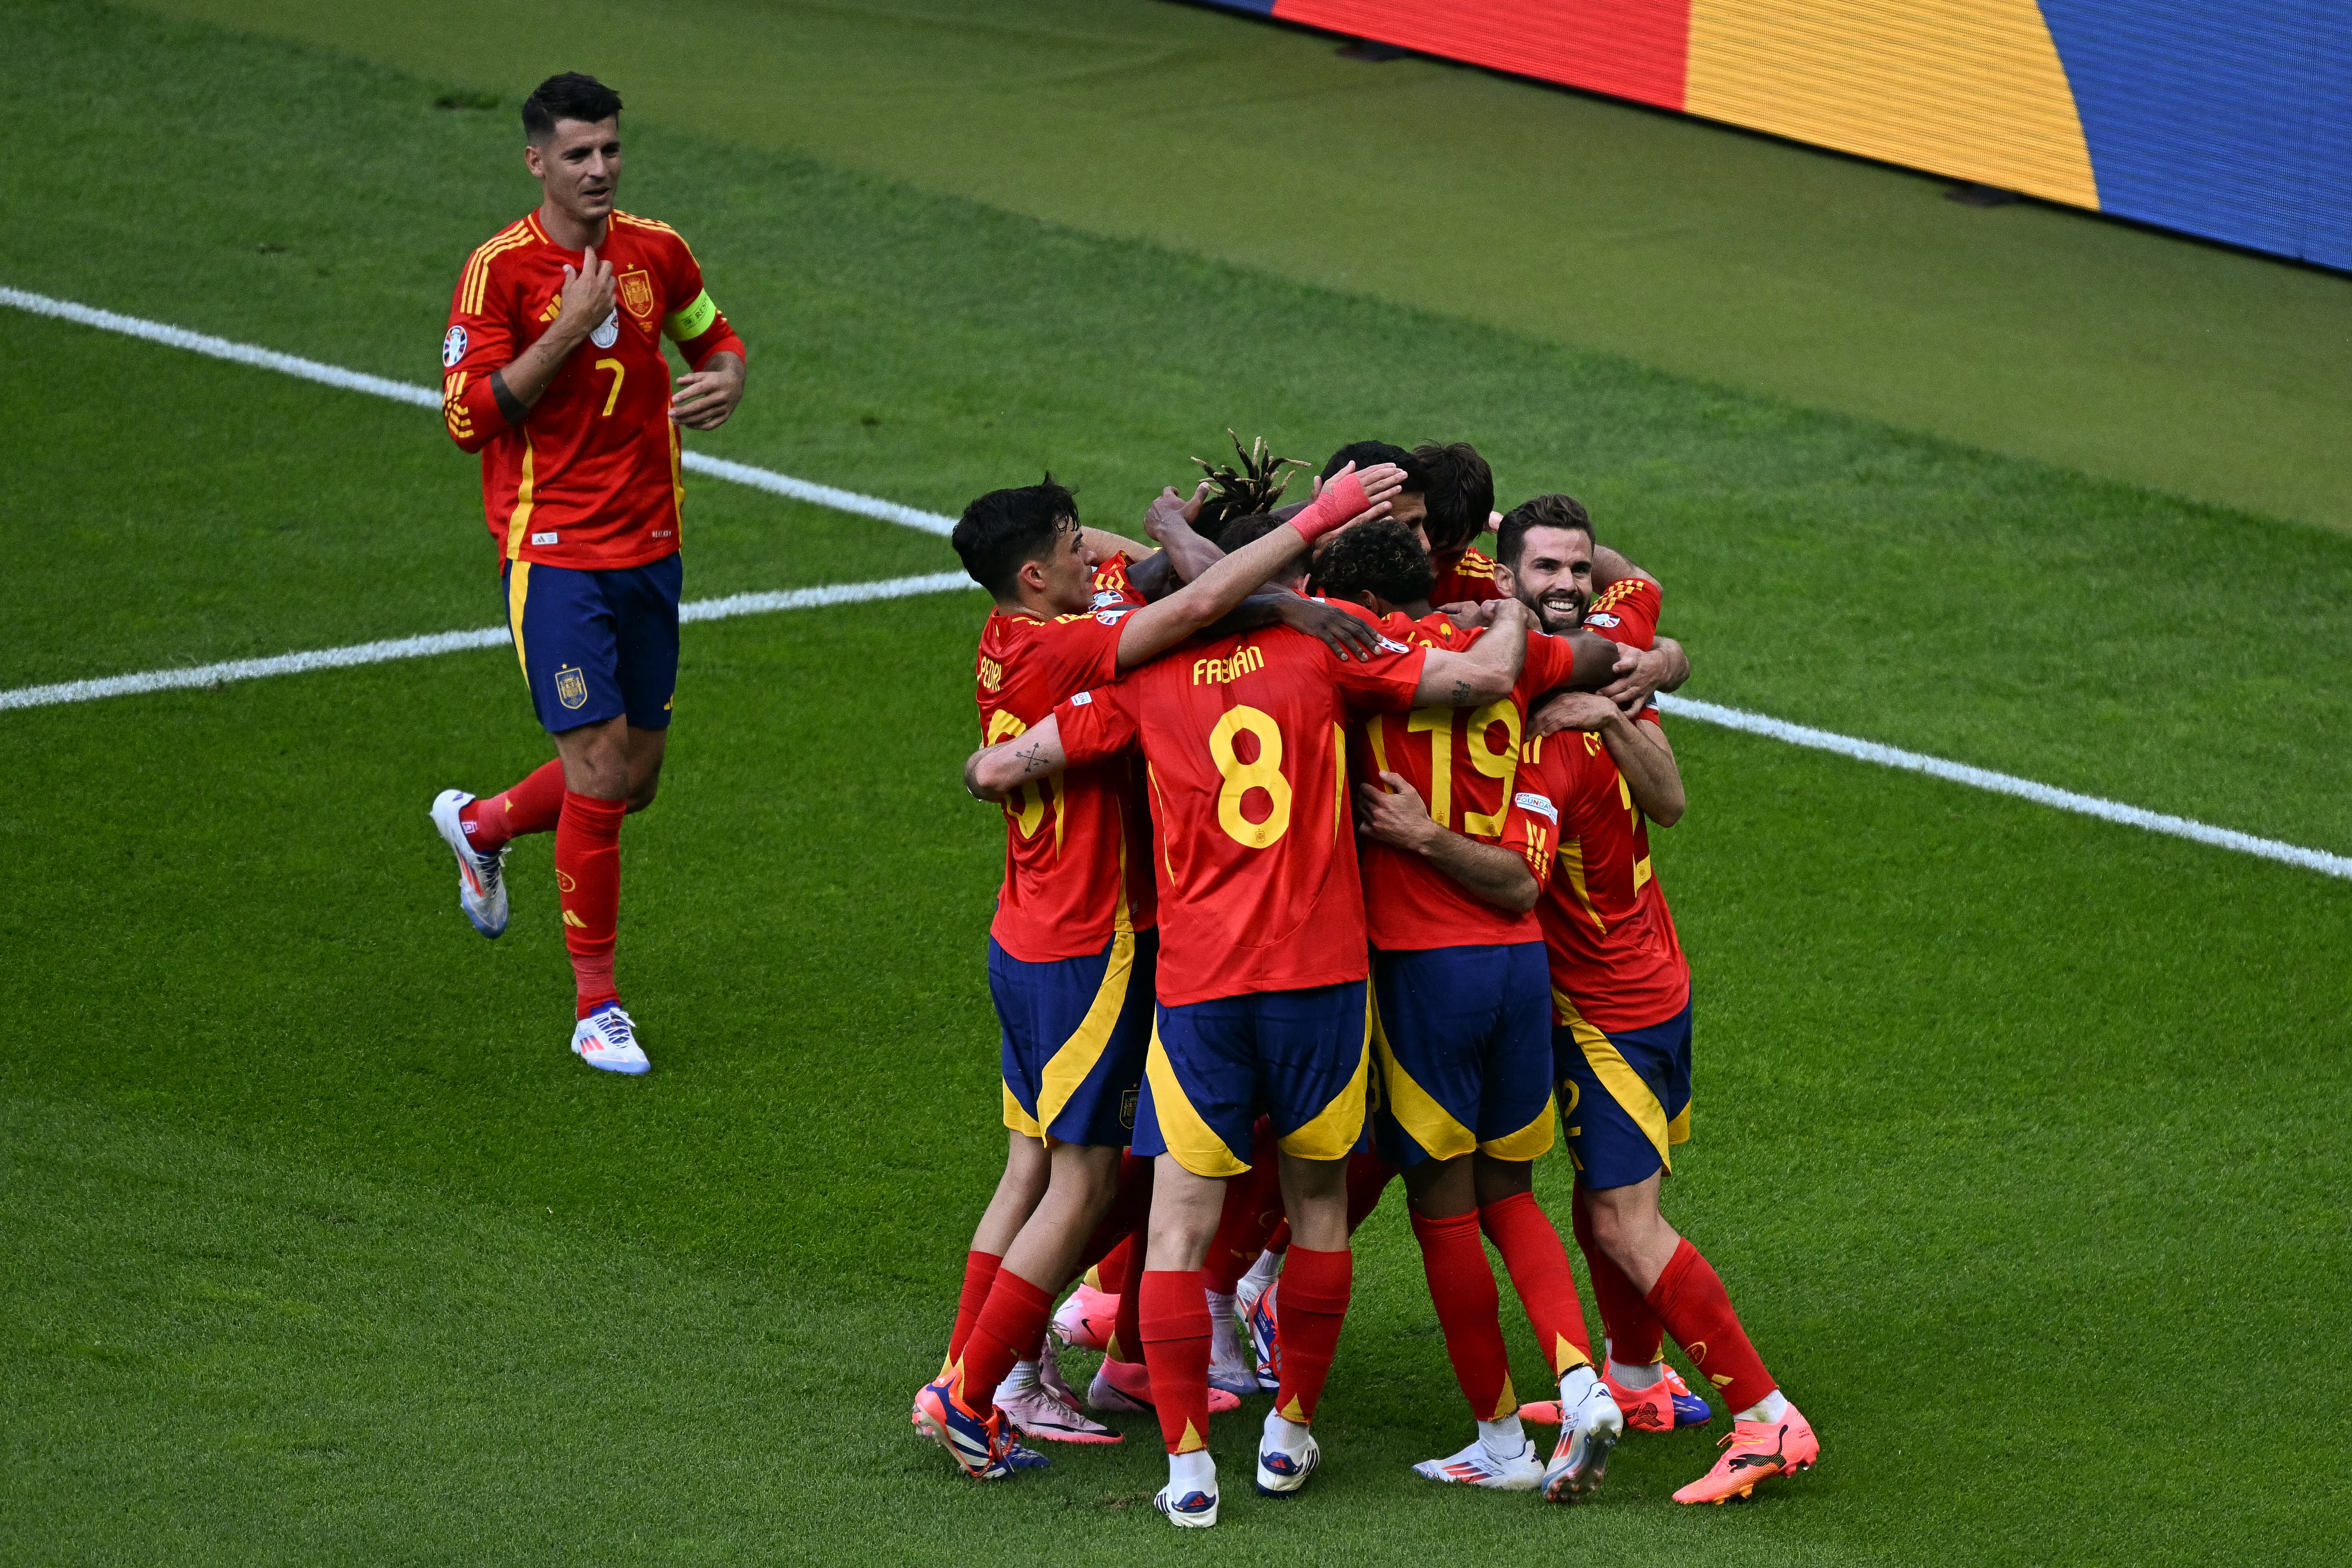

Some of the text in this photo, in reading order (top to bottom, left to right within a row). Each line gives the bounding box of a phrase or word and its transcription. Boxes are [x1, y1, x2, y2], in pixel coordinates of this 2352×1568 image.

[595, 358, 625, 416] 7
[977, 656, 1002, 691] PEDRI
[1194, 645, 1264, 685] FABIÁN
[1209, 704, 1292, 849] 8
[1408, 699, 1521, 836] 19
[1562, 1079, 1581, 1137] 2
